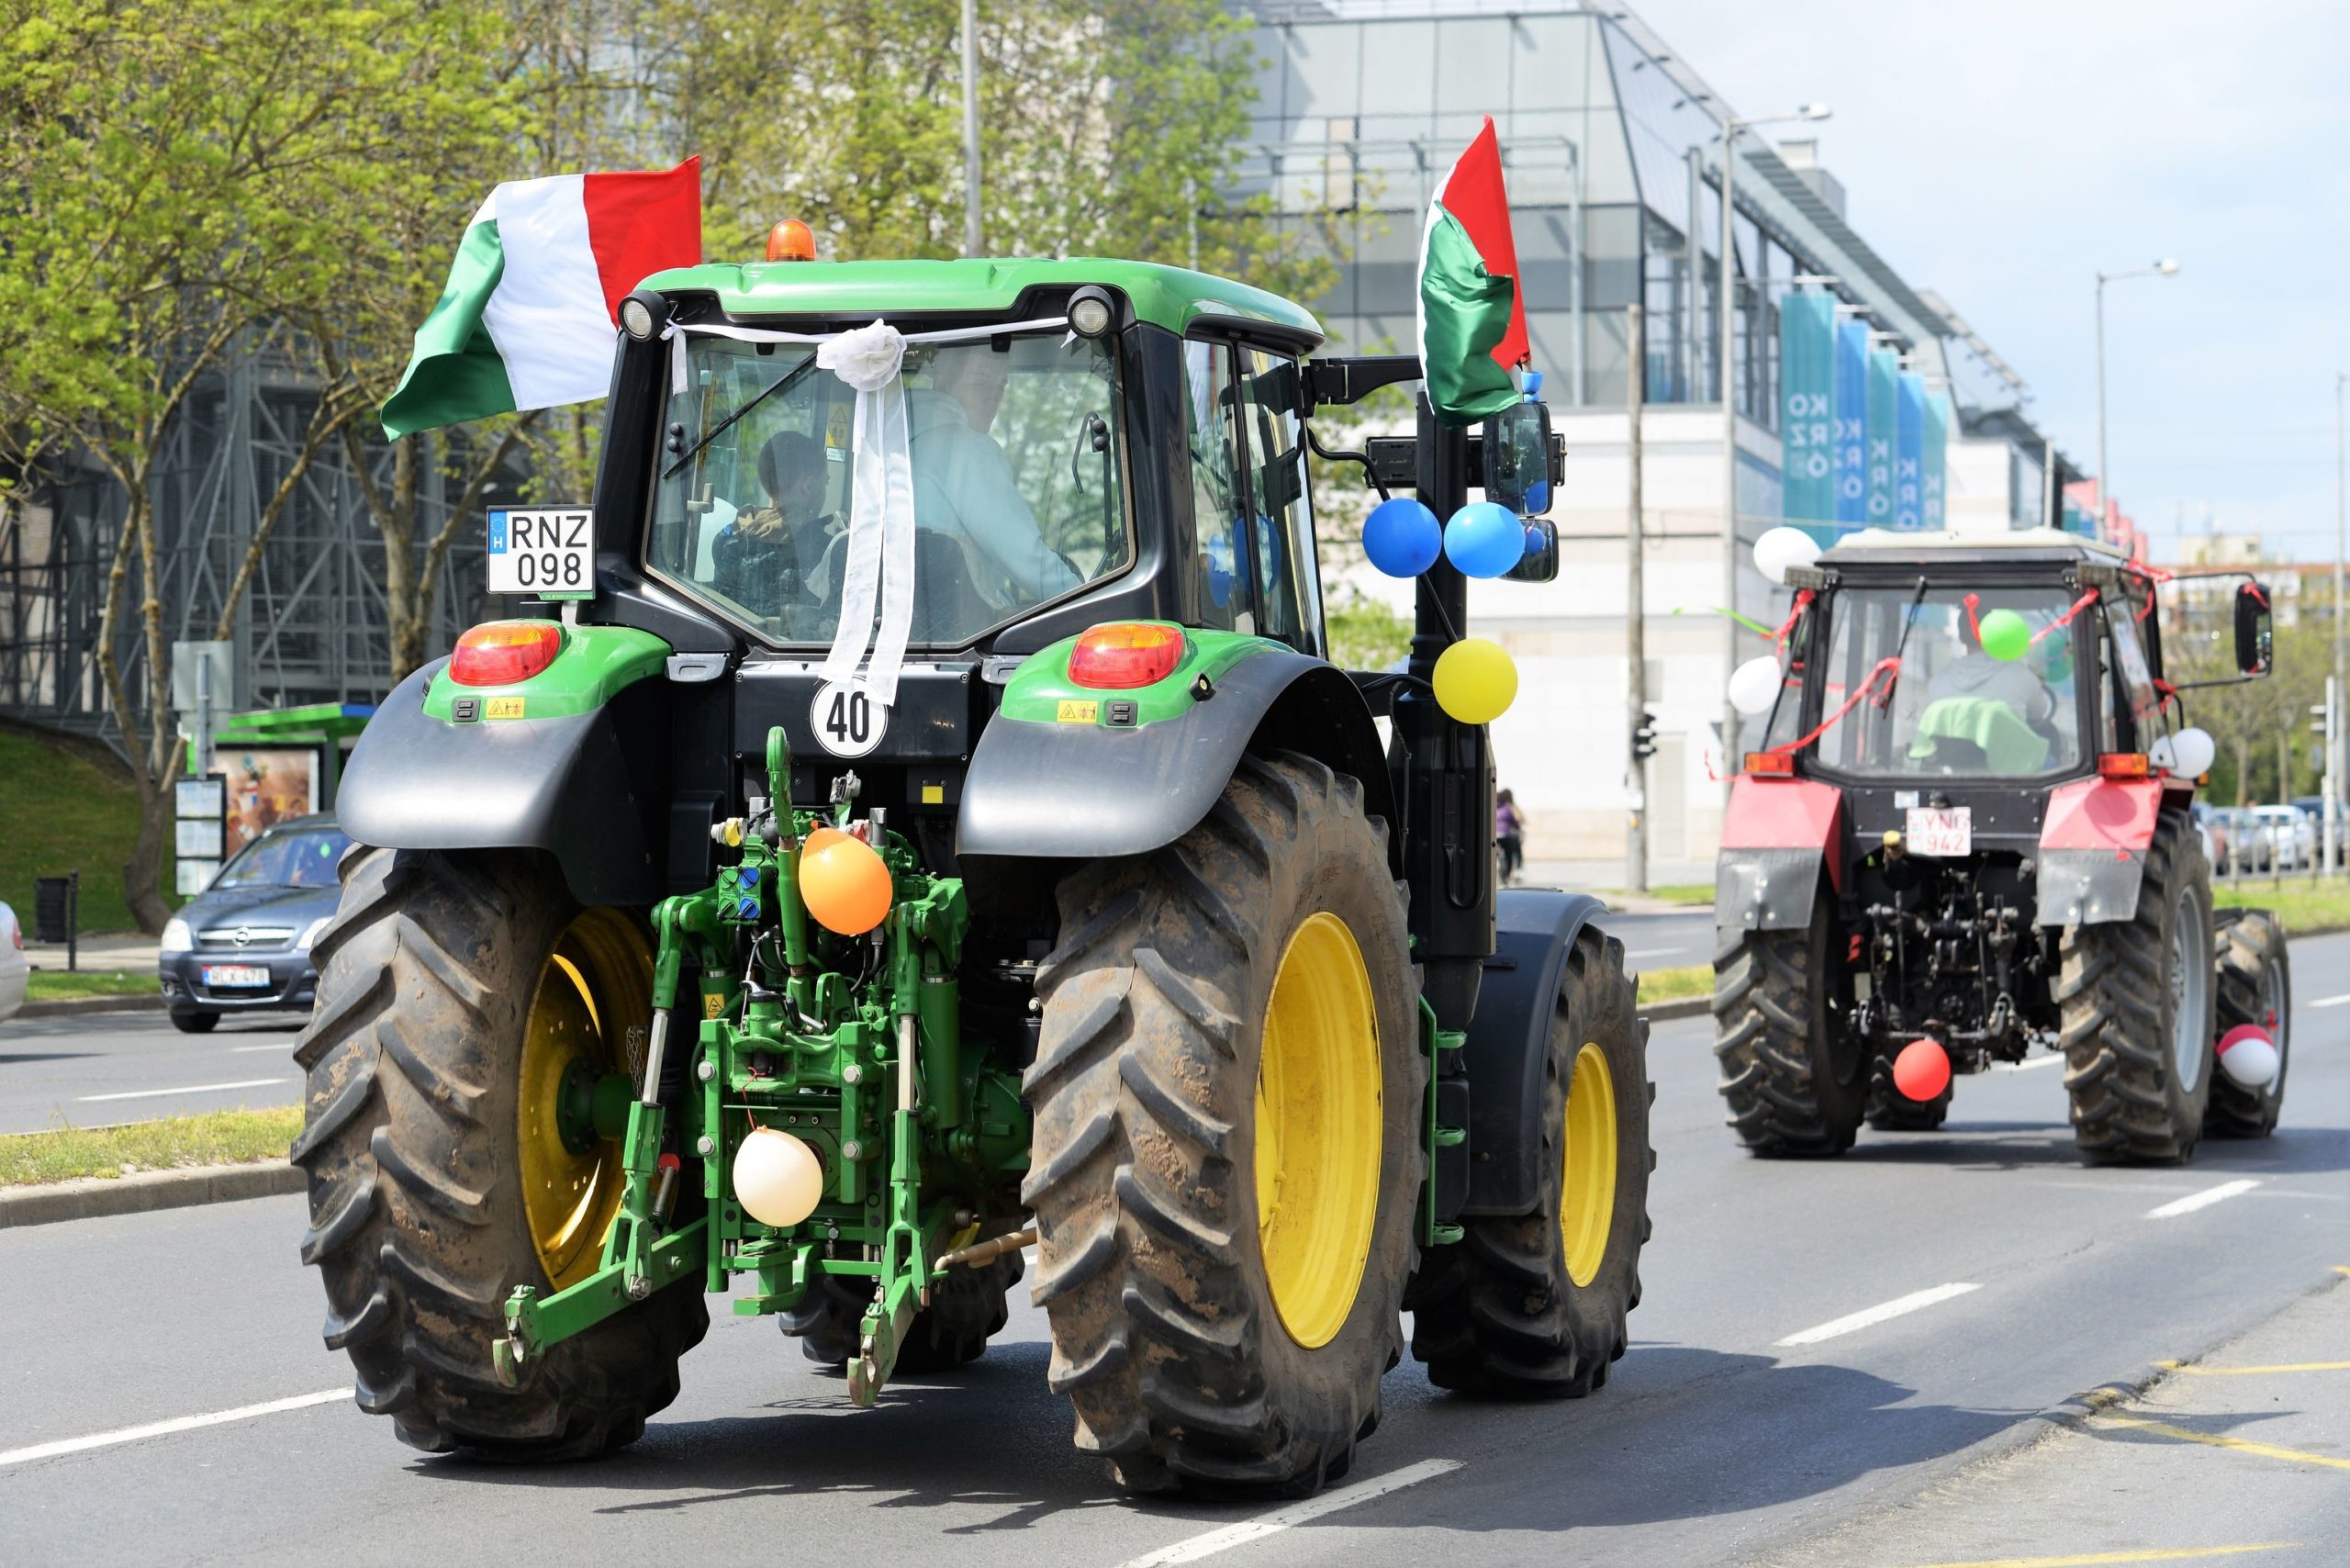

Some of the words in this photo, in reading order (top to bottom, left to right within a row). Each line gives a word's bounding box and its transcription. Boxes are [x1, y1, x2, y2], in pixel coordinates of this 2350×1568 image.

[493, 536, 503, 549] H
[511, 515, 588, 549] RNZ
[518, 553, 581, 586] 098
[826, 690, 869, 744] 40
[1928, 834, 1964, 852] 942
